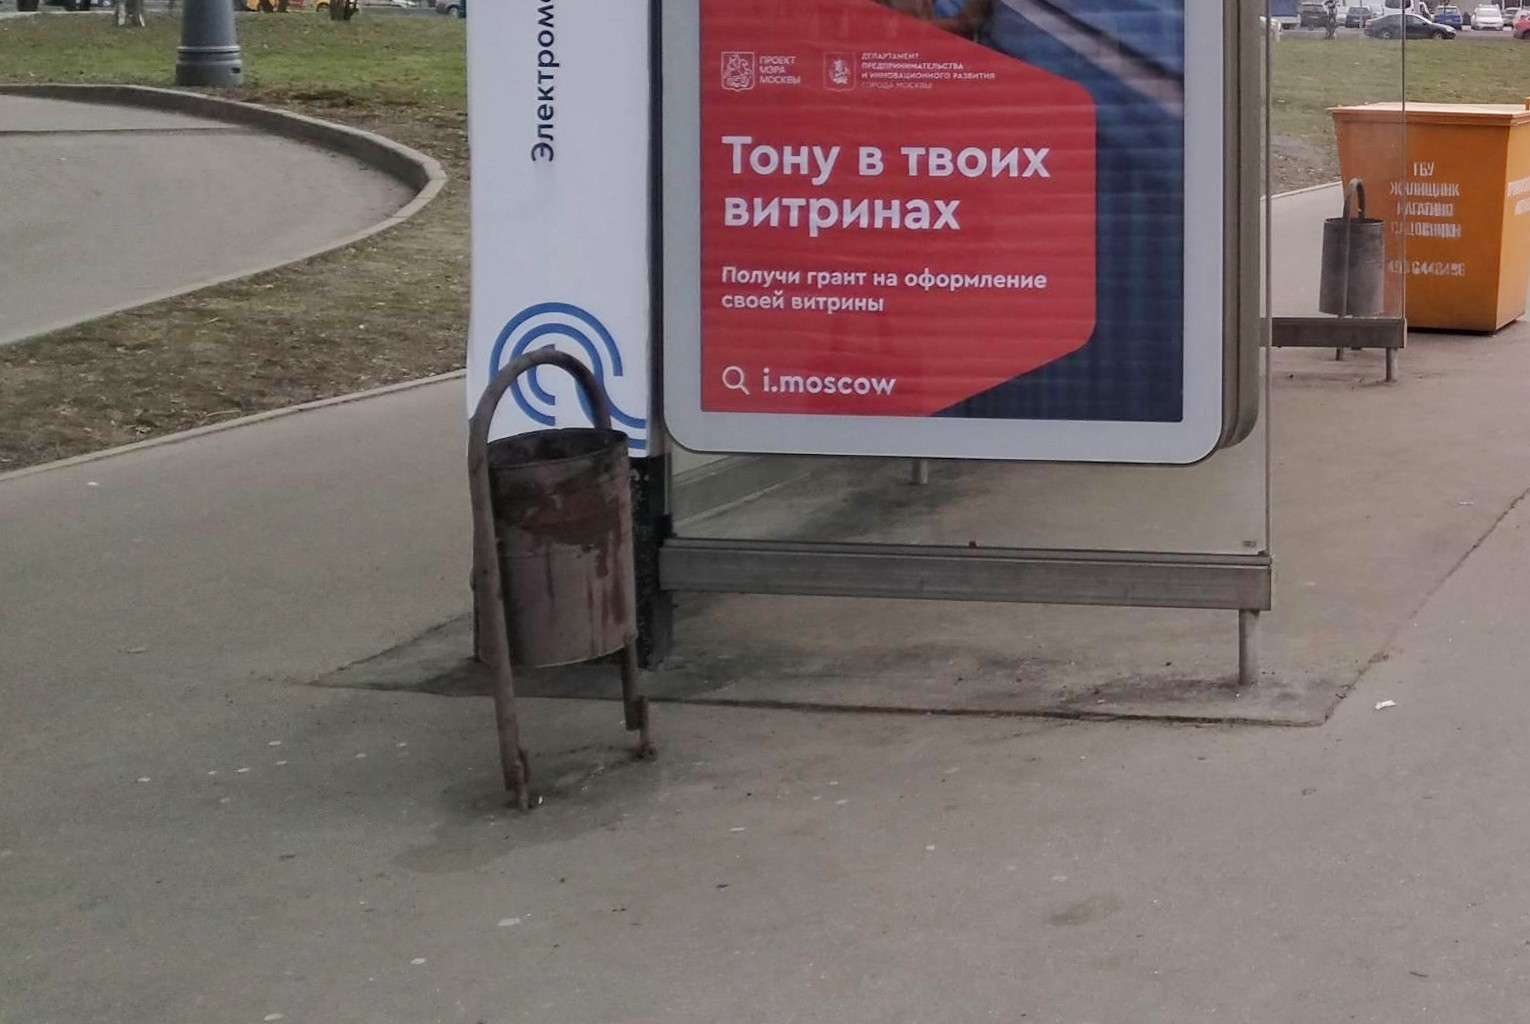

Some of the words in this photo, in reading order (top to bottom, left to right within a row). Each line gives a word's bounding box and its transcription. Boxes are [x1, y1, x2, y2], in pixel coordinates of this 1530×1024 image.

[759, 55, 797, 65] ПРОЕКТ
[861, 52, 920, 60] ДЕПАРТАМЕНТ
[759, 66, 786, 75] МЭРА
[759, 75, 801, 85] МОСКВЫ
[721, 135, 840, 186] Тону
[858, 146, 884, 176] в
[900, 146, 1050, 178] твоих
[1413, 161, 1434, 176] ГБУ
[724, 197, 961, 238] витринах
[721, 266, 800, 287] Получи
[806, 270, 867, 290] грант
[873, 273, 898, 287] на
[904, 268, 1047, 292] оформление
[721, 291, 784, 309] своей
[791, 295, 884, 314] витрины
[762, 367, 896, 395] i.moscow
